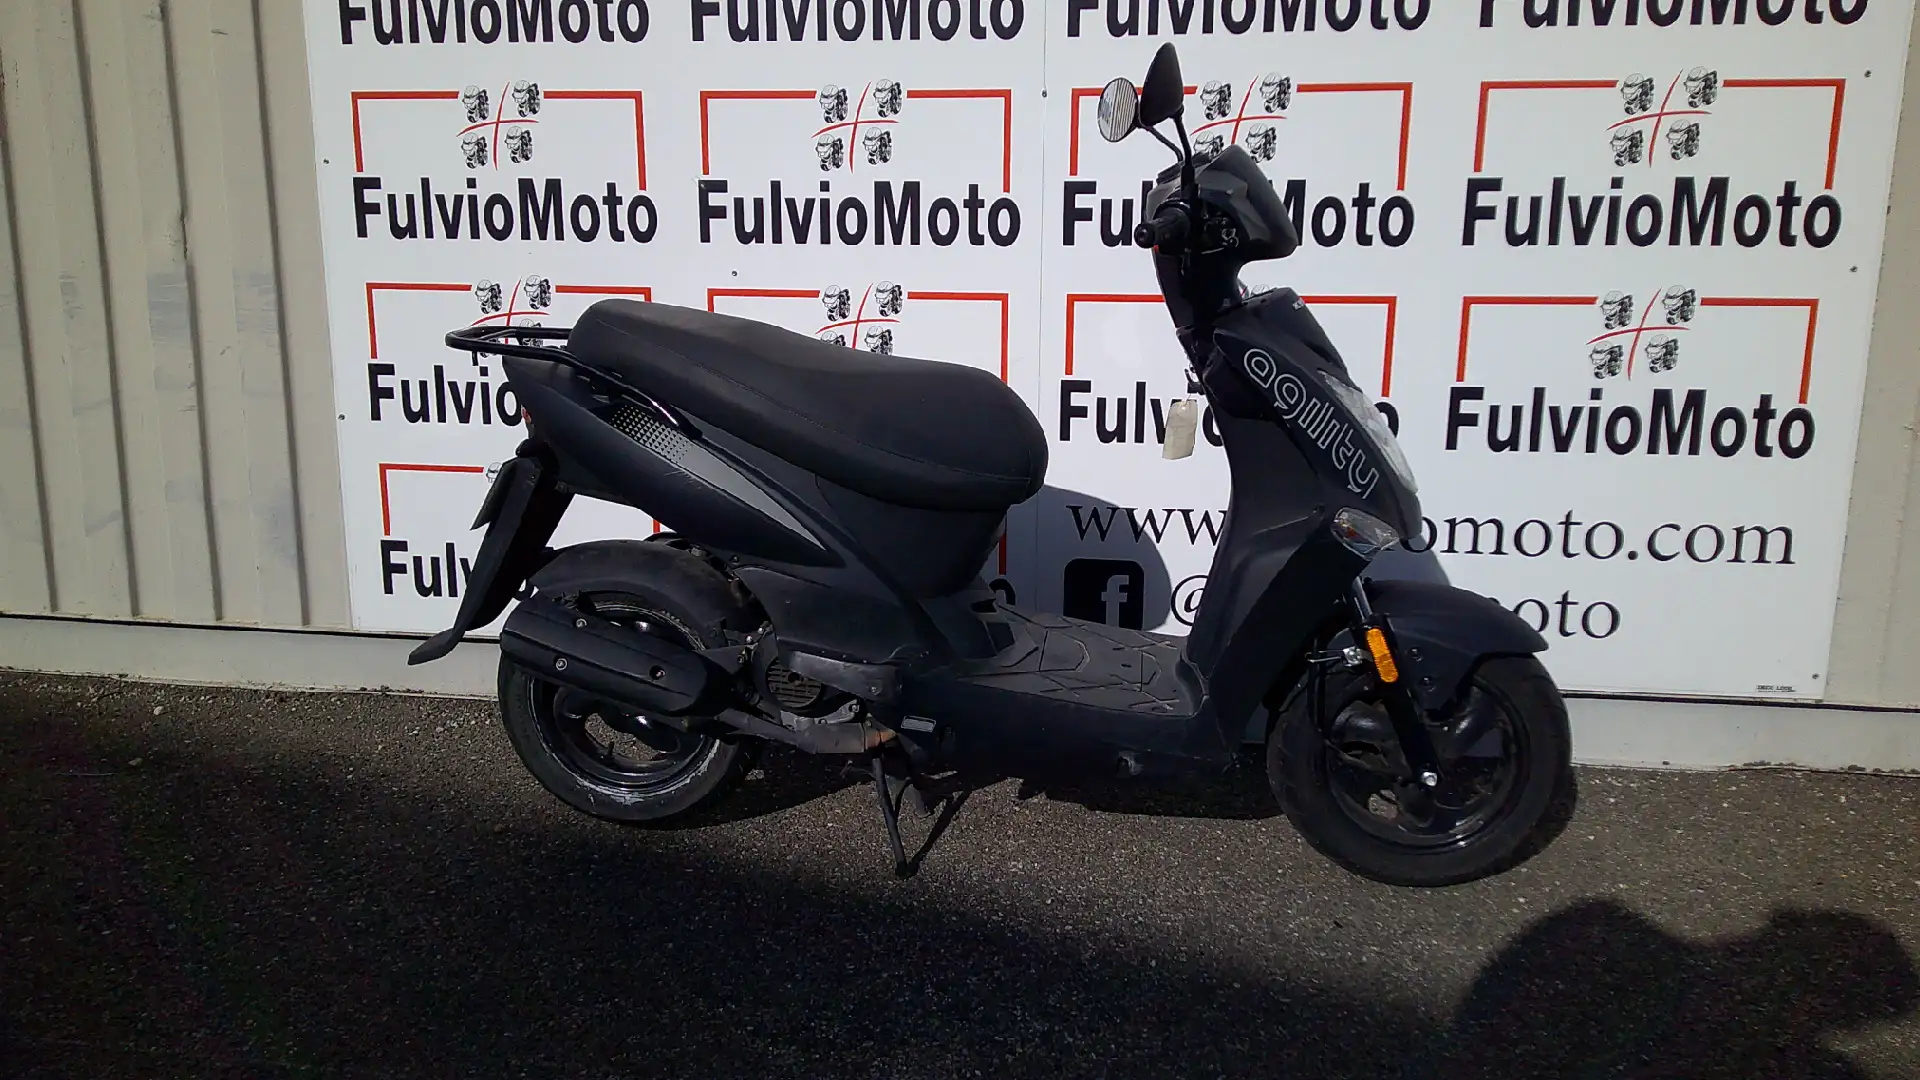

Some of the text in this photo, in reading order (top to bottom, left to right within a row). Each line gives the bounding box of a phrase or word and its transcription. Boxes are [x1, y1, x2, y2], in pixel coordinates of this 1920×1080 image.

[339, 0, 649, 45] FulvioMoto
[691, 0, 1024, 42] FulvioMoto
[353, 177, 657, 243] FulvioMoto
[698, 180, 1021, 247] FulvioMoto
[1461, 176, 1842, 248] FulvioMoto
[1445, 386, 1815, 460] FulvioMoto
